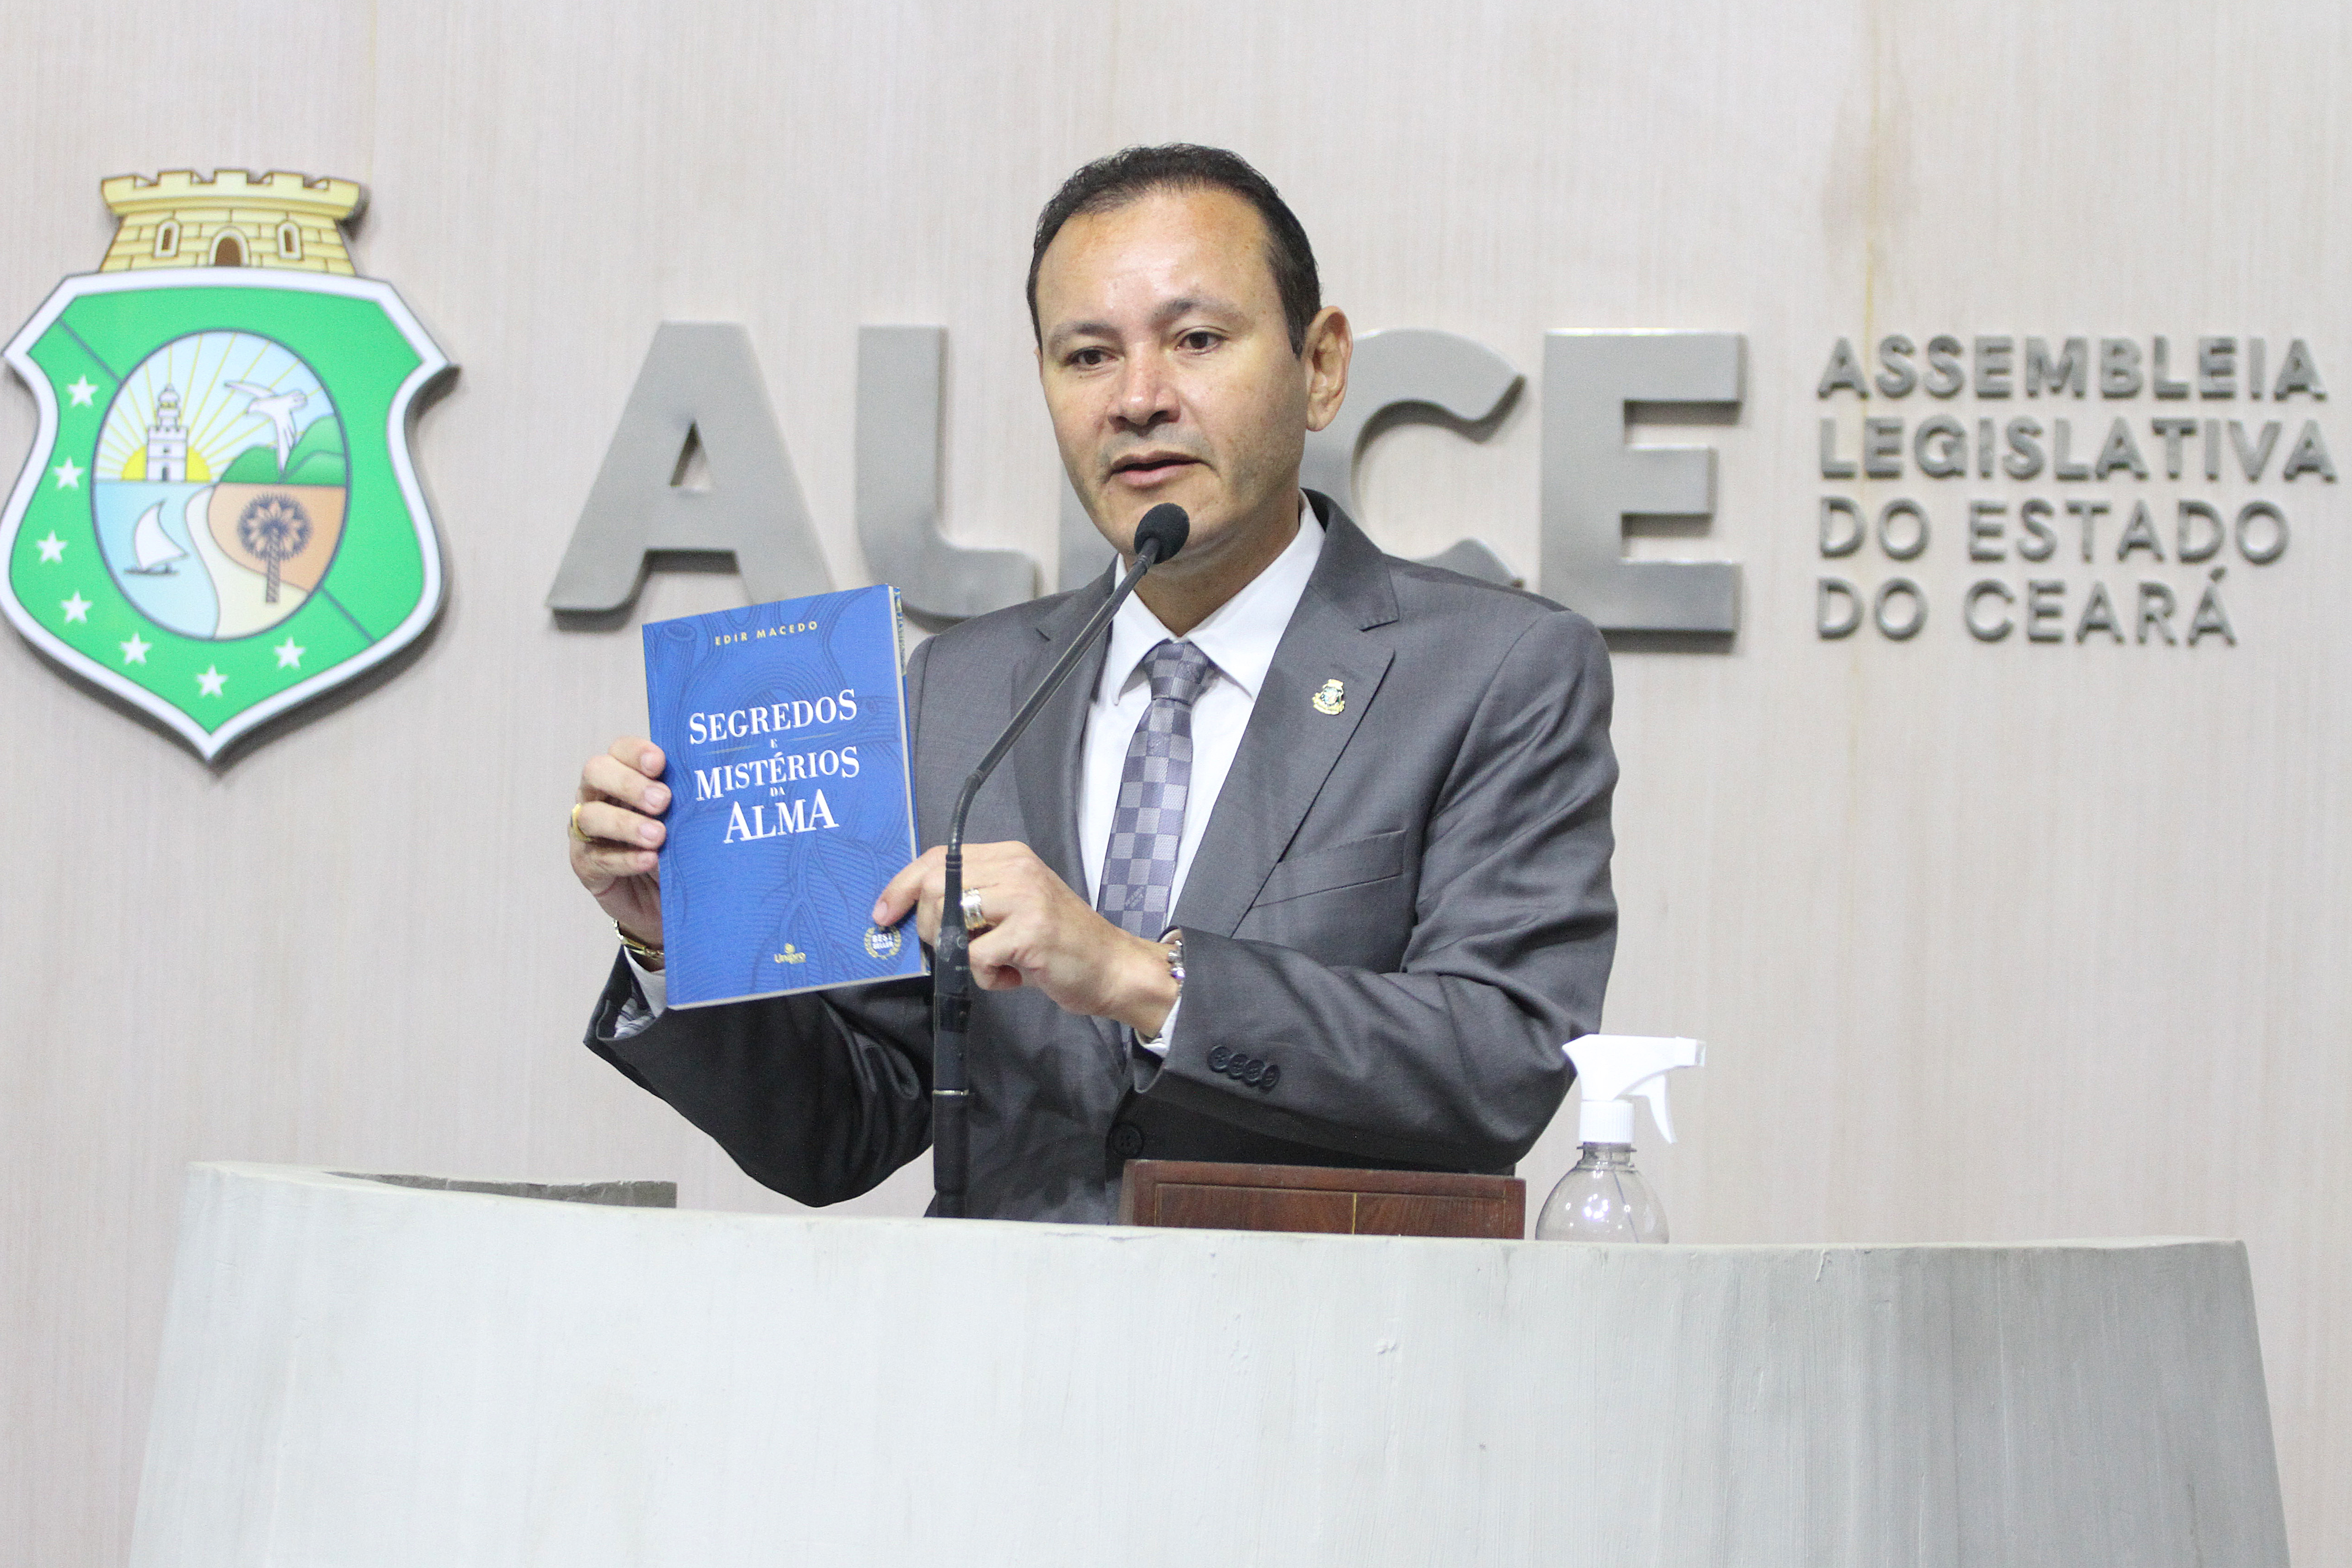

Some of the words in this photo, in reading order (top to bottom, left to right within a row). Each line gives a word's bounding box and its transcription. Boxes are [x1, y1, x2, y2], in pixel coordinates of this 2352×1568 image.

[1818, 335, 2328, 401] ASSEMBLEIA
[1818, 415, 2338, 484] LEGISLATIVA
[547, 320, 1746, 641] ALCE
[1819, 496, 1932, 562] DO
[1969, 497, 2291, 566] ESTADO
[715, 632, 748, 646] EDIR
[756, 621, 818, 639] MACEDO
[1816, 576, 1930, 642] DO
[1964, 566, 2238, 647] CEARÁ
[689, 688, 858, 745] SEGREDOS
[769, 738, 779, 749] E
[694, 746, 860, 801] MISTÉRIOS
[769, 786, 786, 797] DA
[723, 789, 840, 844] ALMA
